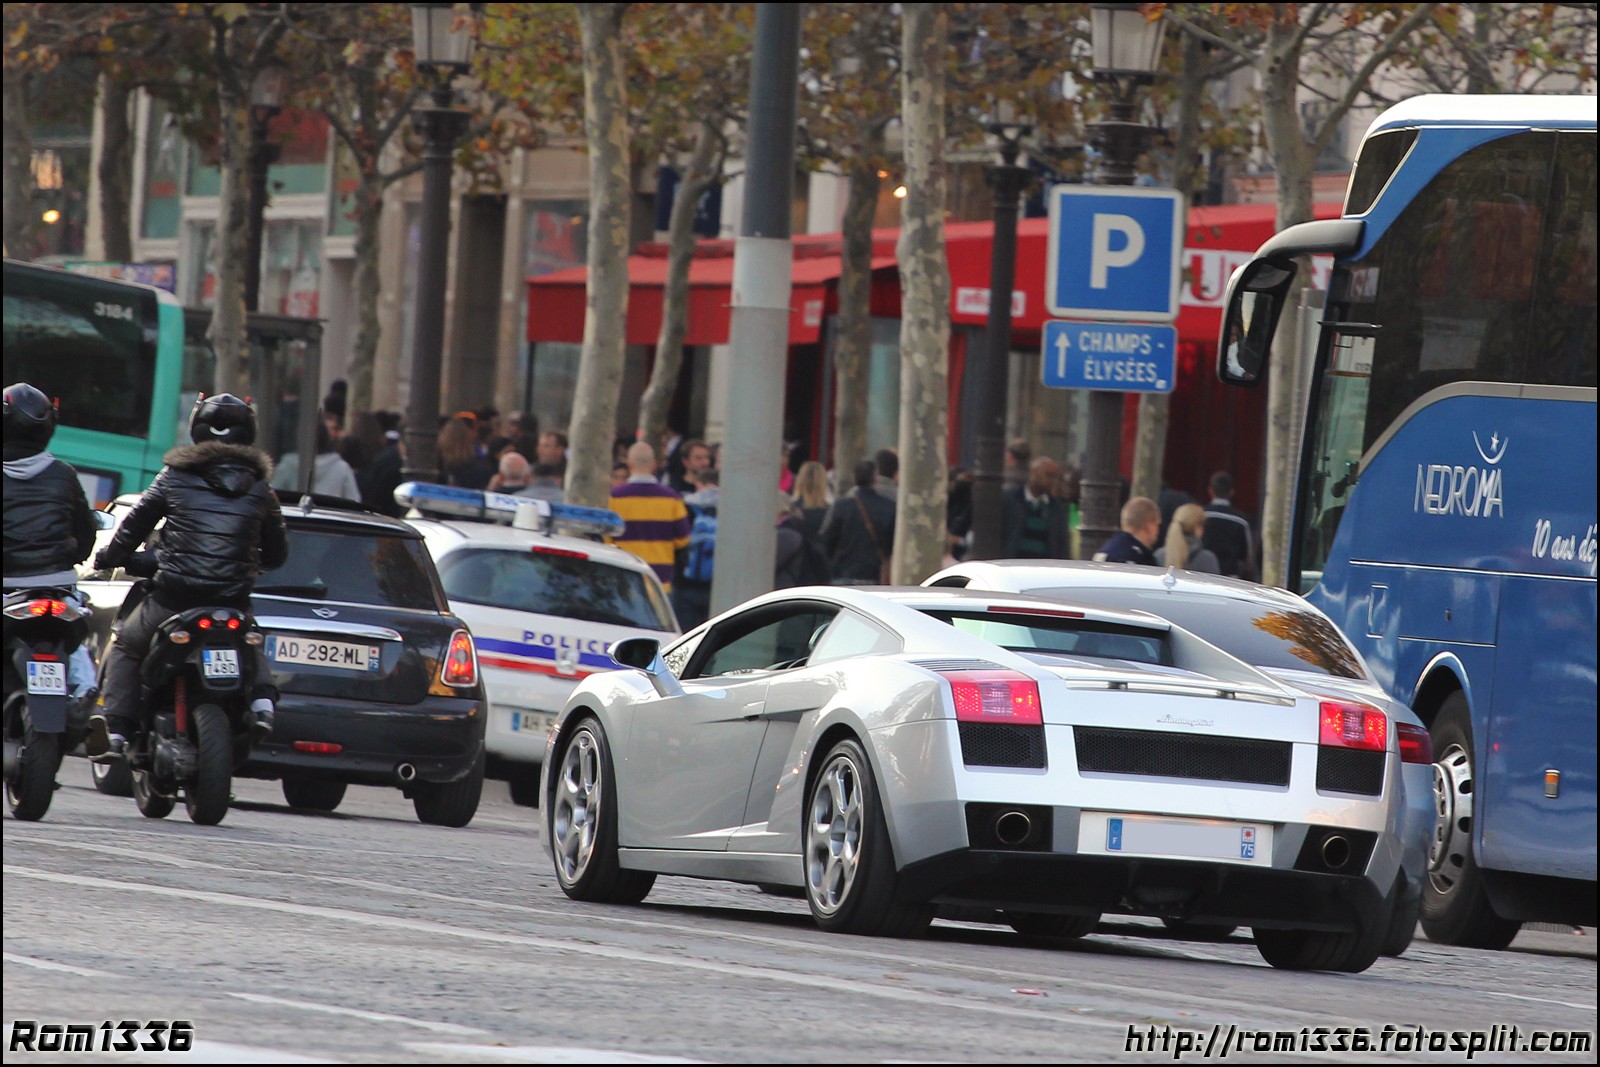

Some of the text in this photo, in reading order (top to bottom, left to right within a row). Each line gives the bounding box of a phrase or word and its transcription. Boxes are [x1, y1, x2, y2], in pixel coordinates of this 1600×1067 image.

[1089, 213, 1146, 289] P
[1078, 331, 1152, 355] CHAMPS
[1083, 356, 1158, 383] ÉLYSÉES
[1414, 464, 1504, 518] NEDROMA
[1532, 518, 1551, 558] 10
[1551, 535, 1575, 560] ans
[278, 642, 364, 665] AD-292-ML
[1241, 843, 1254, 857] 75
